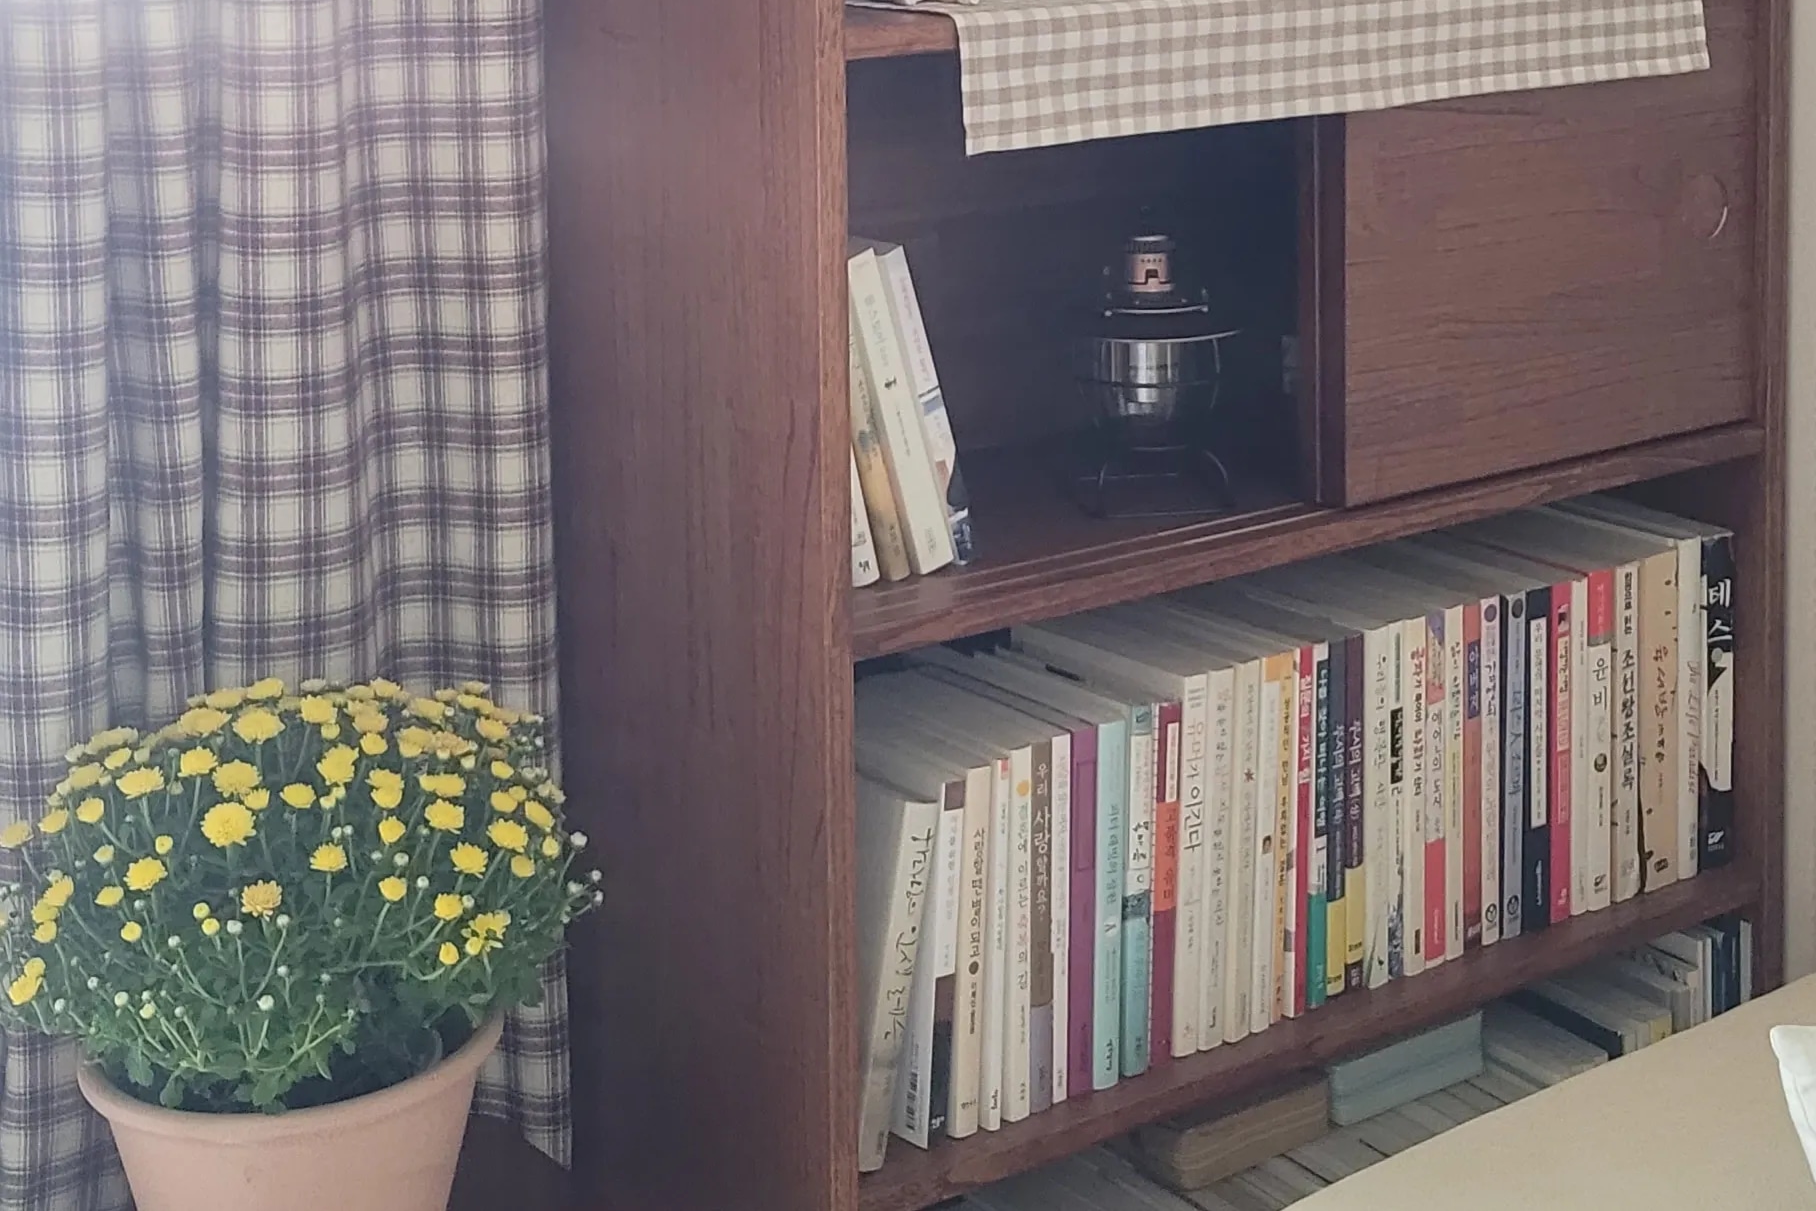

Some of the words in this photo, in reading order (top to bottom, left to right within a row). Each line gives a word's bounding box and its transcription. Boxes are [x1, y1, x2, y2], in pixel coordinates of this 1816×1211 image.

[1707, 578, 1733, 643] 테스
[1468, 646, 1479, 716] 아버지
[1592, 657, 1609, 711] 윤비
[1186, 720, 1204, 778] 유머가
[1621, 649, 1636, 791] 조선왕조실록
[1036, 762, 1049, 796] 우리
[1184, 785, 1204, 852] 이긴다
[972, 827, 986, 876] 사랑할
[1033, 805, 1052, 921] 사랑할까요?
